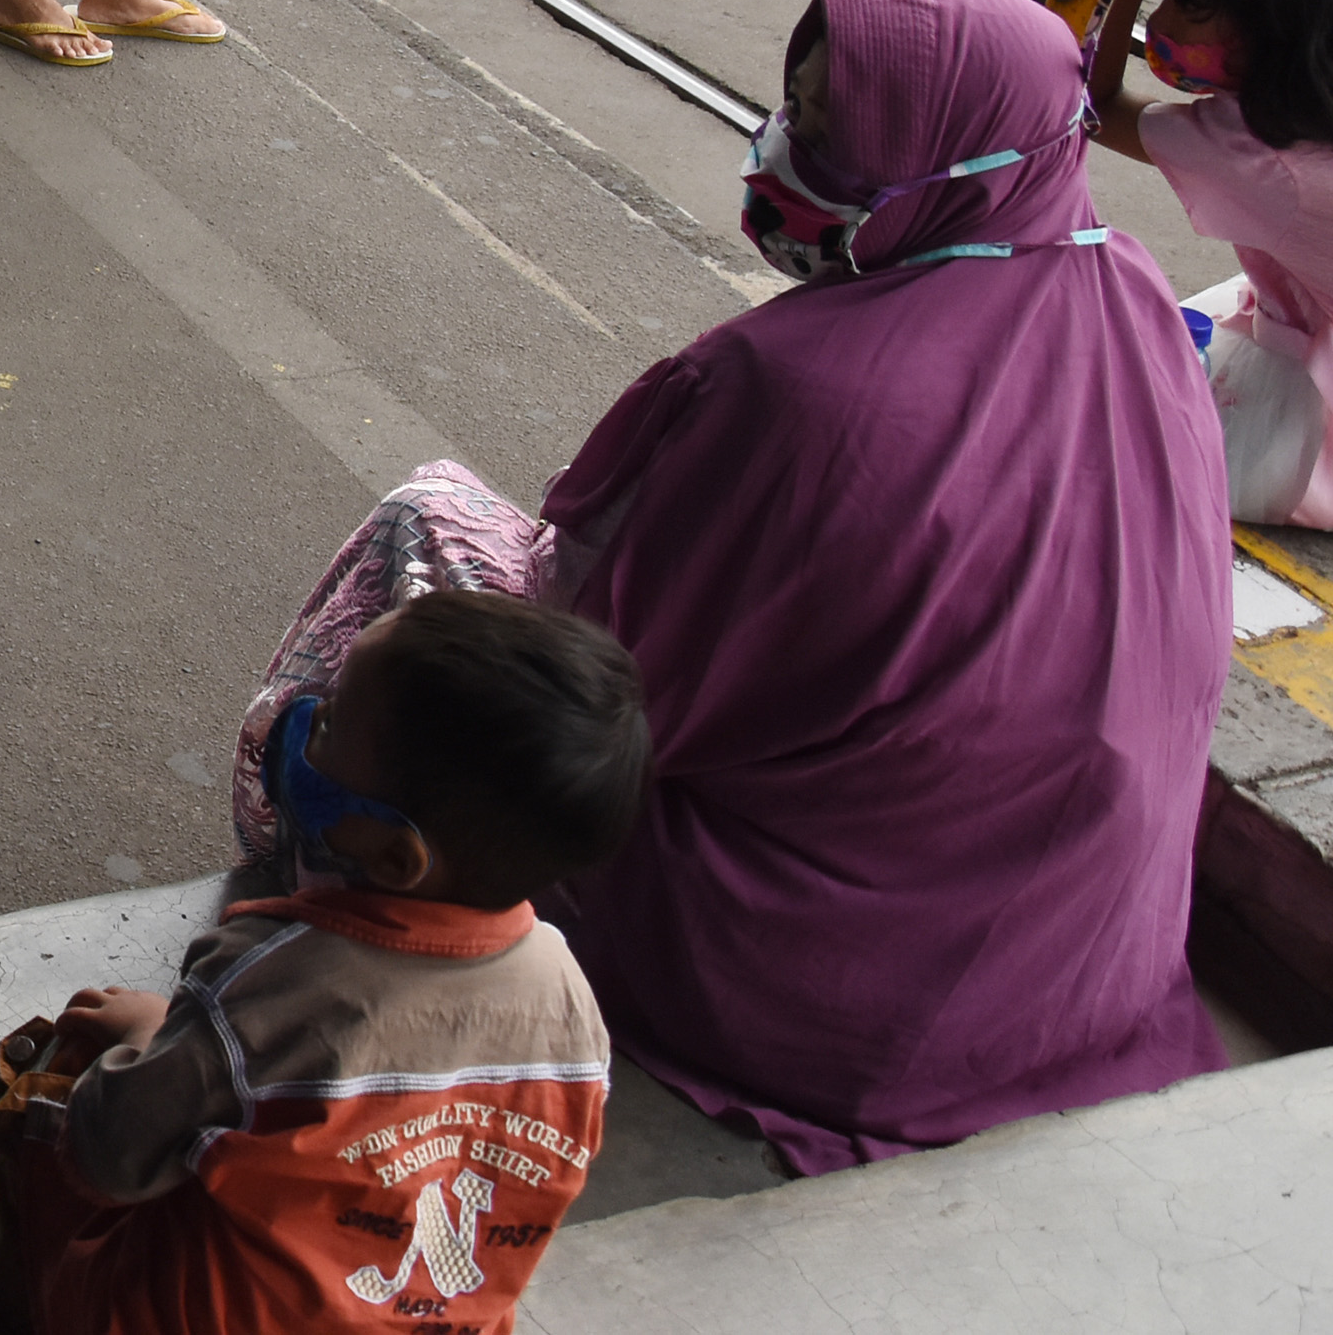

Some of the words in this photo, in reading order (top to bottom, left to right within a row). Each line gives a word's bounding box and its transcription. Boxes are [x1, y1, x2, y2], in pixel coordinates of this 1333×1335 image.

[376, 1134, 464, 1190] FASHION
[469, 1138, 552, 1188] SHIRT
[500, 1109, 591, 1170] WORLD
[485, 1223, 553, 1249] 1957
